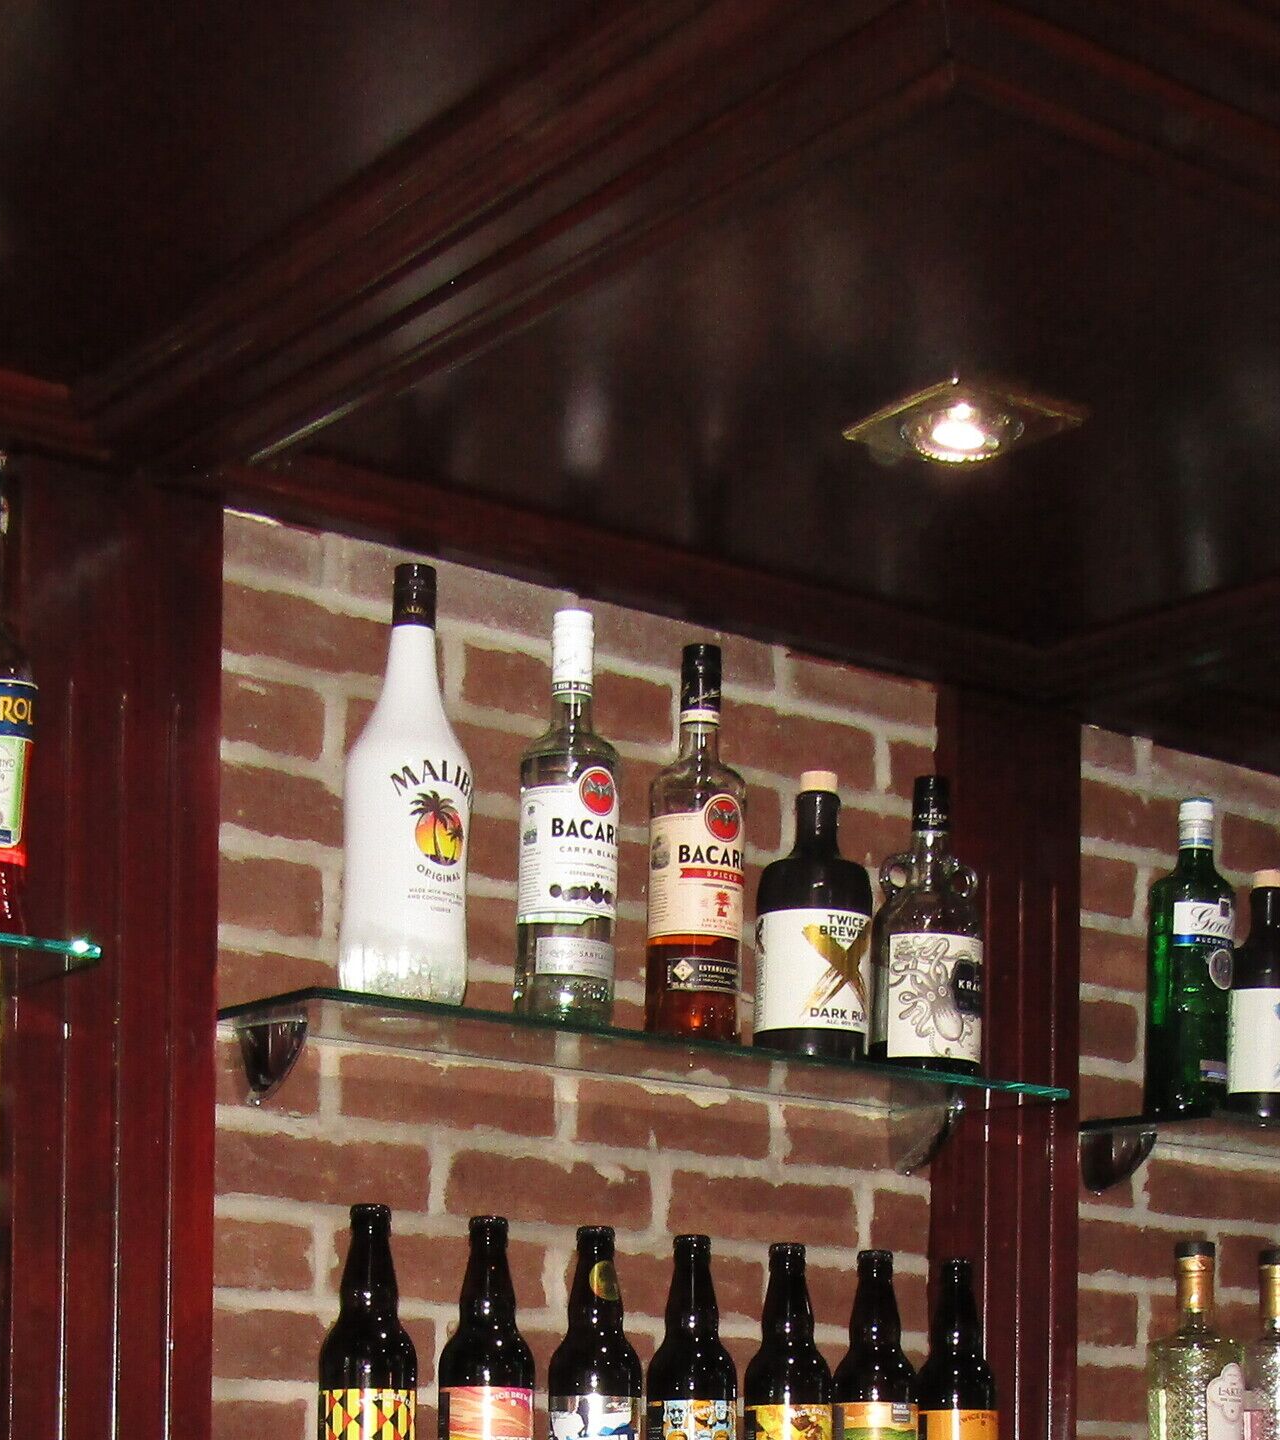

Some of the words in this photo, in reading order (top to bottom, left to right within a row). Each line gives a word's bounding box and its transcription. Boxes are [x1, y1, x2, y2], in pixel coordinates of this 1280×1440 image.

[416, 864, 461, 883] ORIGINAL
[827, 914, 865, 928] TWICE
[810, 1007, 848, 1019] DARK
